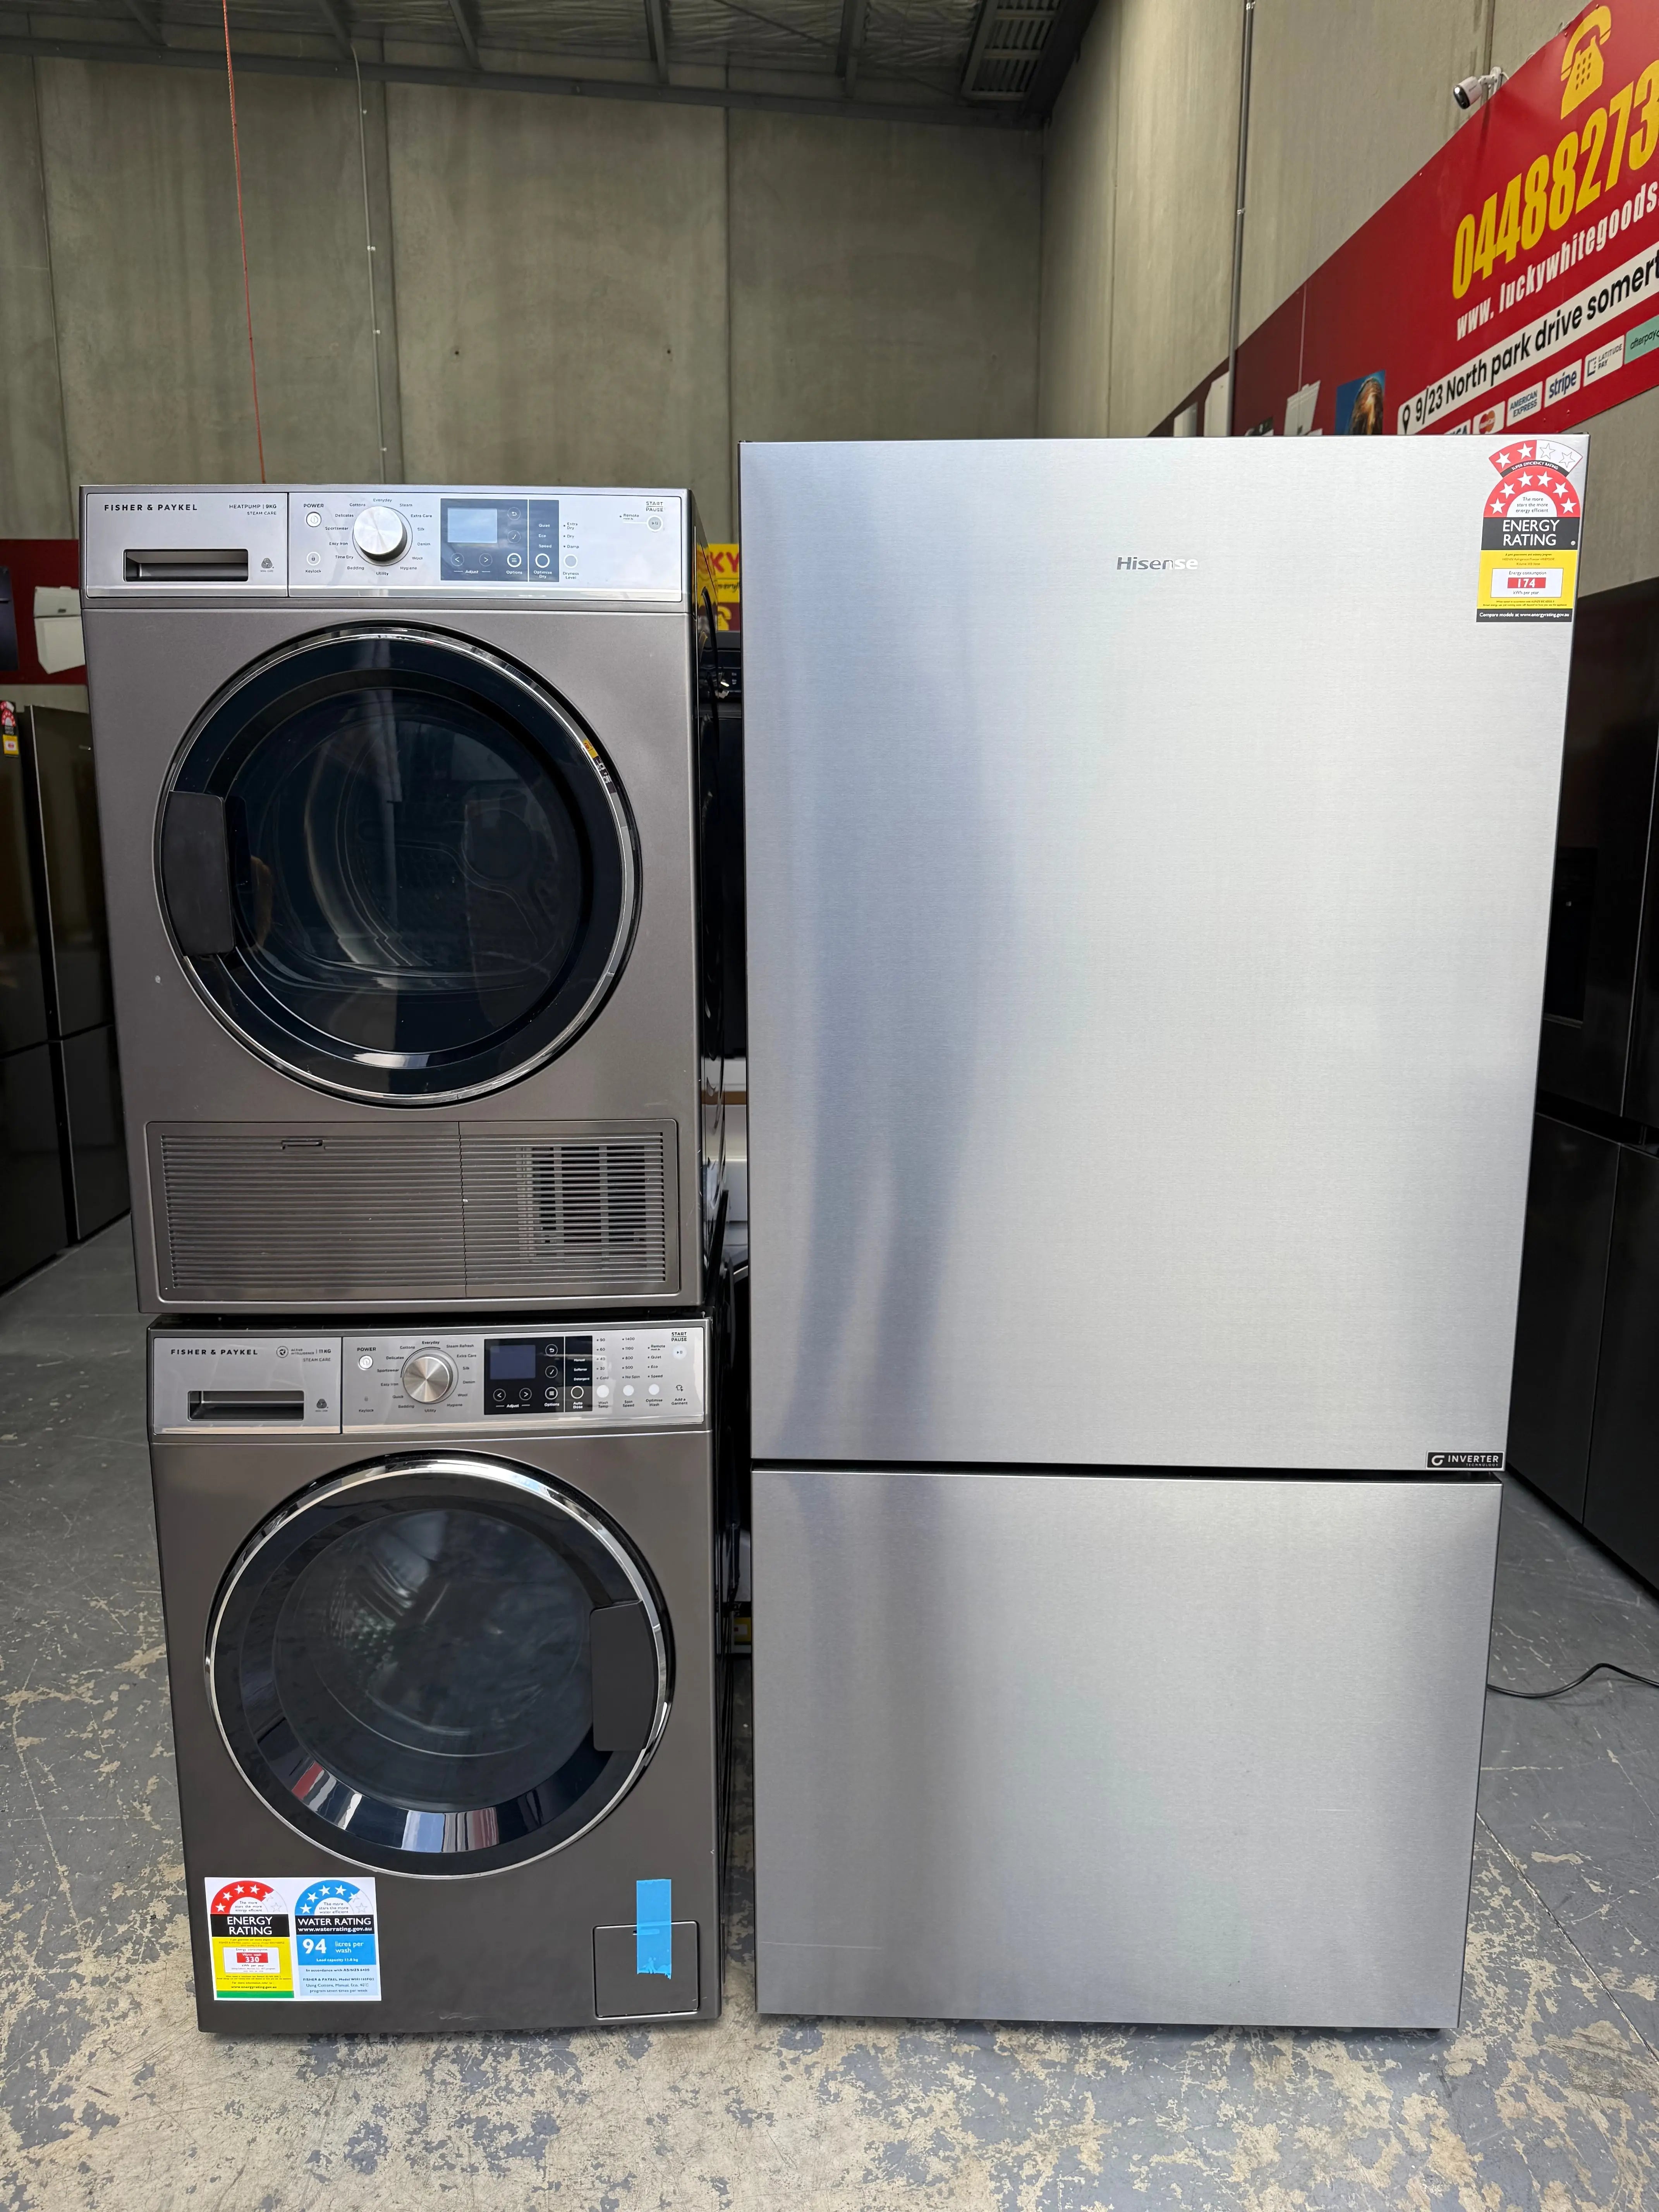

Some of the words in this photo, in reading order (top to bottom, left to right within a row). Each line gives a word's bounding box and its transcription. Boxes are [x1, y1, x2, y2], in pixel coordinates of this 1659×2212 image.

[1457, 297, 1494, 341] www.
[1630, 330, 1657, 349] afterpay
[1598, 343, 1623, 362] LATITUDE
[1415, 384, 1443, 425] 9/23
[1446, 362, 1487, 404] North
[1491, 333, 1532, 386] park
[1535, 304, 1582, 351] drive
[1598, 359, 1608, 369] PAY
[1549, 367, 1577, 399] stripe
[1510, 390, 1537, 410] AMERICAN
[1513, 399, 1537, 417] EXPRESS
[1503, 520, 1559, 532] ENERGY
[1503, 534, 1556, 546] RATING
[1117, 557, 1198, 570] Hisense
[1518, 578, 1535, 588] 174
[227, 1917, 272, 1925] ENERGY
[229, 1927, 272, 1935] RATING
[302, 1939, 327, 1954] 94
